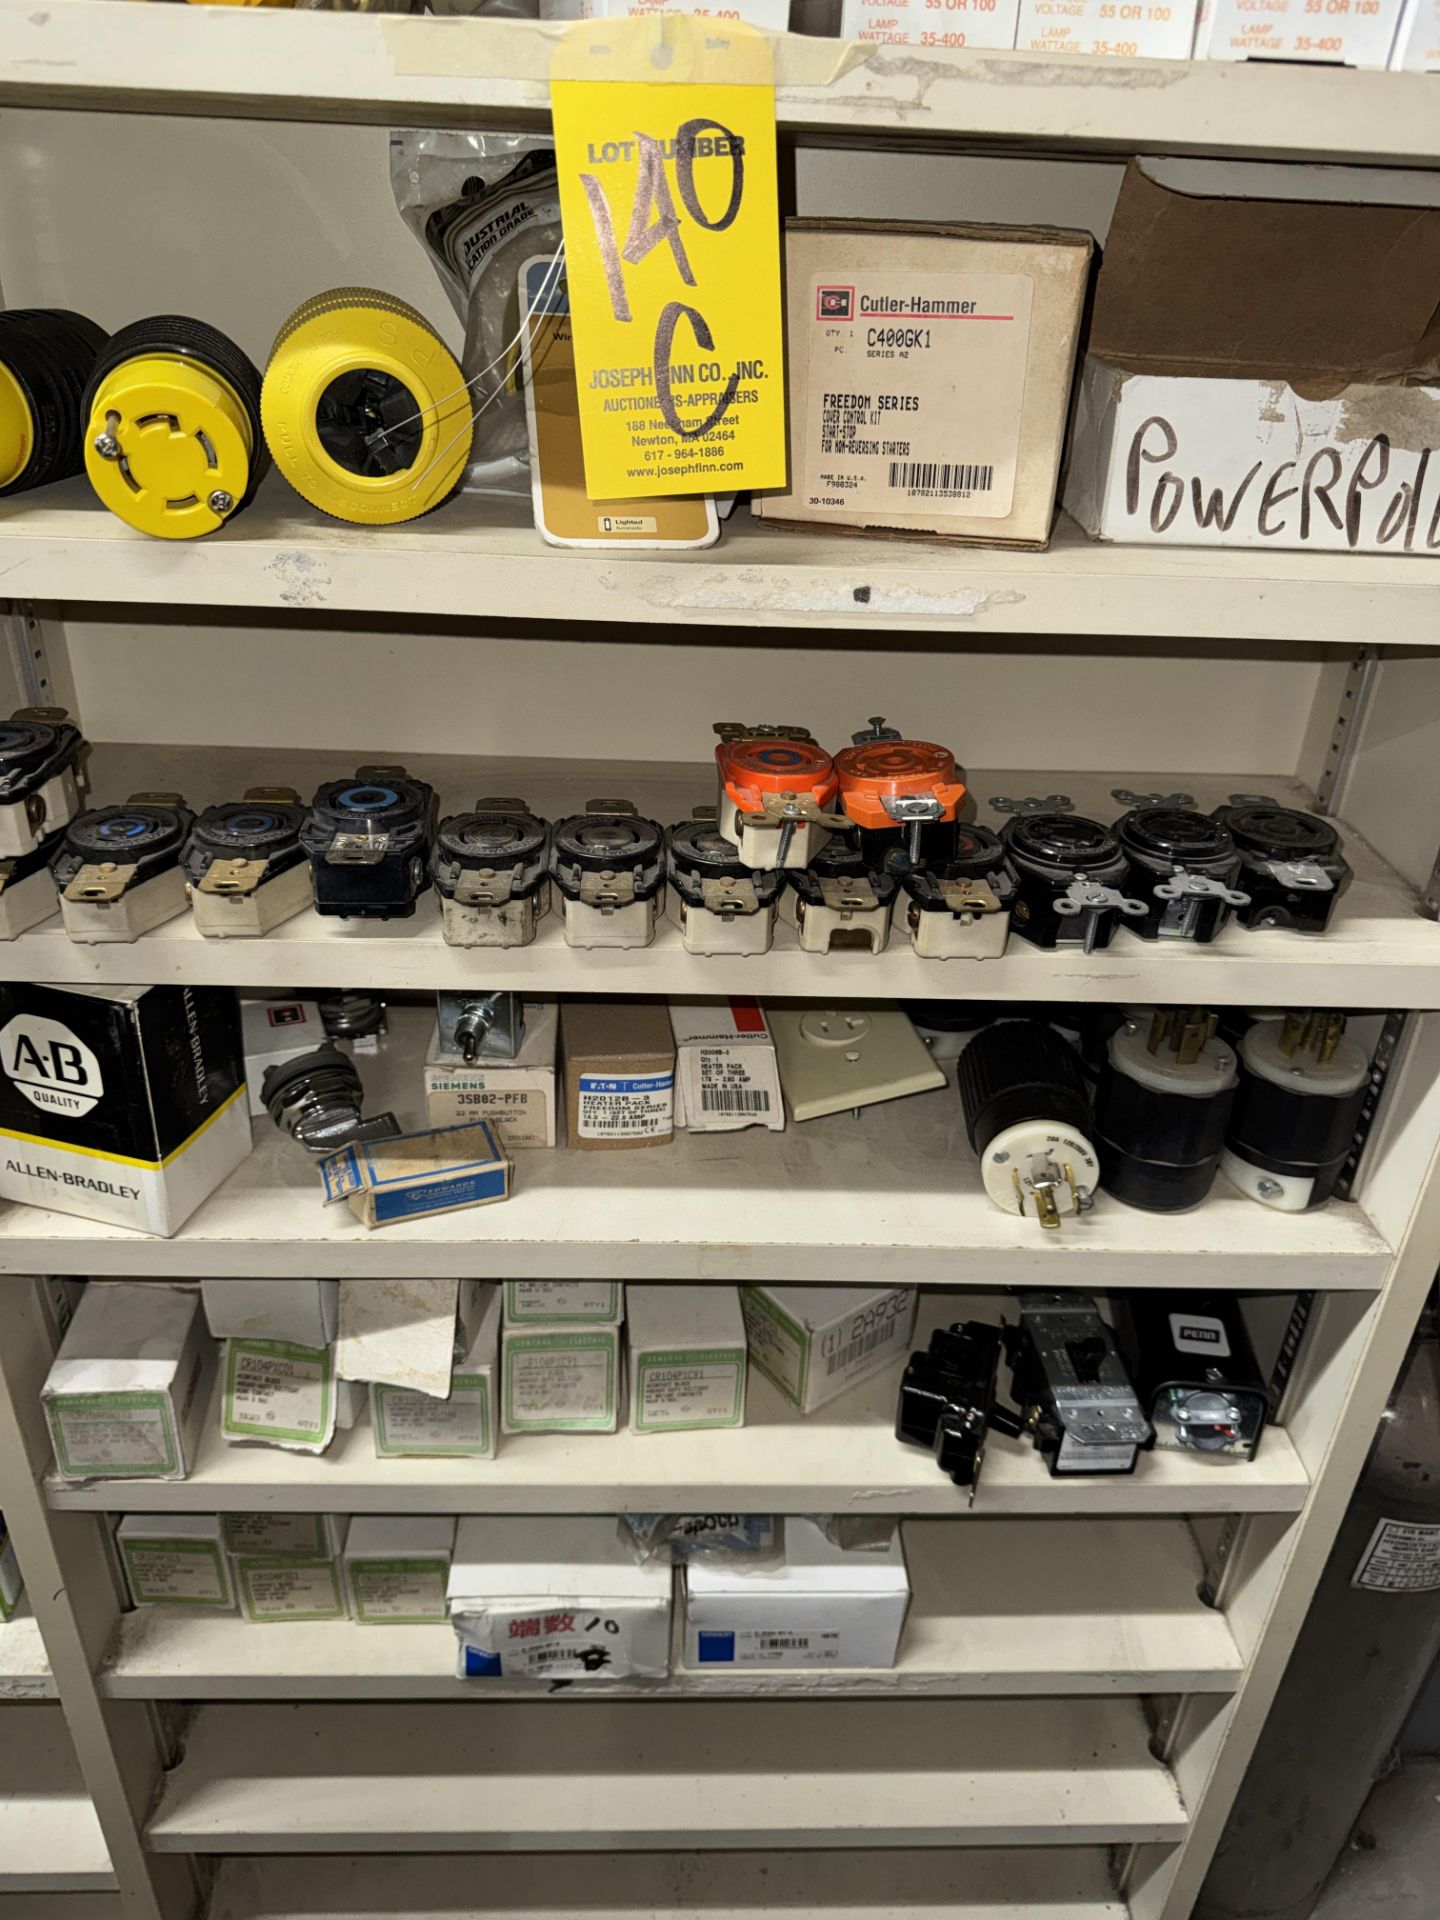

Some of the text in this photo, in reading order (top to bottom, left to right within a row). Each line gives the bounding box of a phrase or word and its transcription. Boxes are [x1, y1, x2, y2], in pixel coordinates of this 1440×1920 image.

[868, 19, 898, 30] LAMP
[858, 31, 966, 47] WATTAGE 35-400
[587, 136, 746, 163] LOT UMBER
[859, 294, 977, 315] Cutler-Hammer
[867, 328, 931, 348] C400GK1
[589, 366, 652, 389] JOSEPH
[653, 301, 739, 438] C
[823, 394, 919, 411] FREEDOM SERIES
[626, 414, 740, 431] 188 Neeham reet
[632, 435, 678, 448] Newton,
[703, 430, 735, 442] 02464
[644, 450, 664, 461] 617
[675, 446, 724, 460] 964-1886
[627, 461, 744, 478] www.josephfinn.com
[431, 1082, 486, 1090] SIEMENS
[33, 1090, 81, 1110] QUALITY
[5, 1158, 141, 1200] ALLEN-BRADLEY
